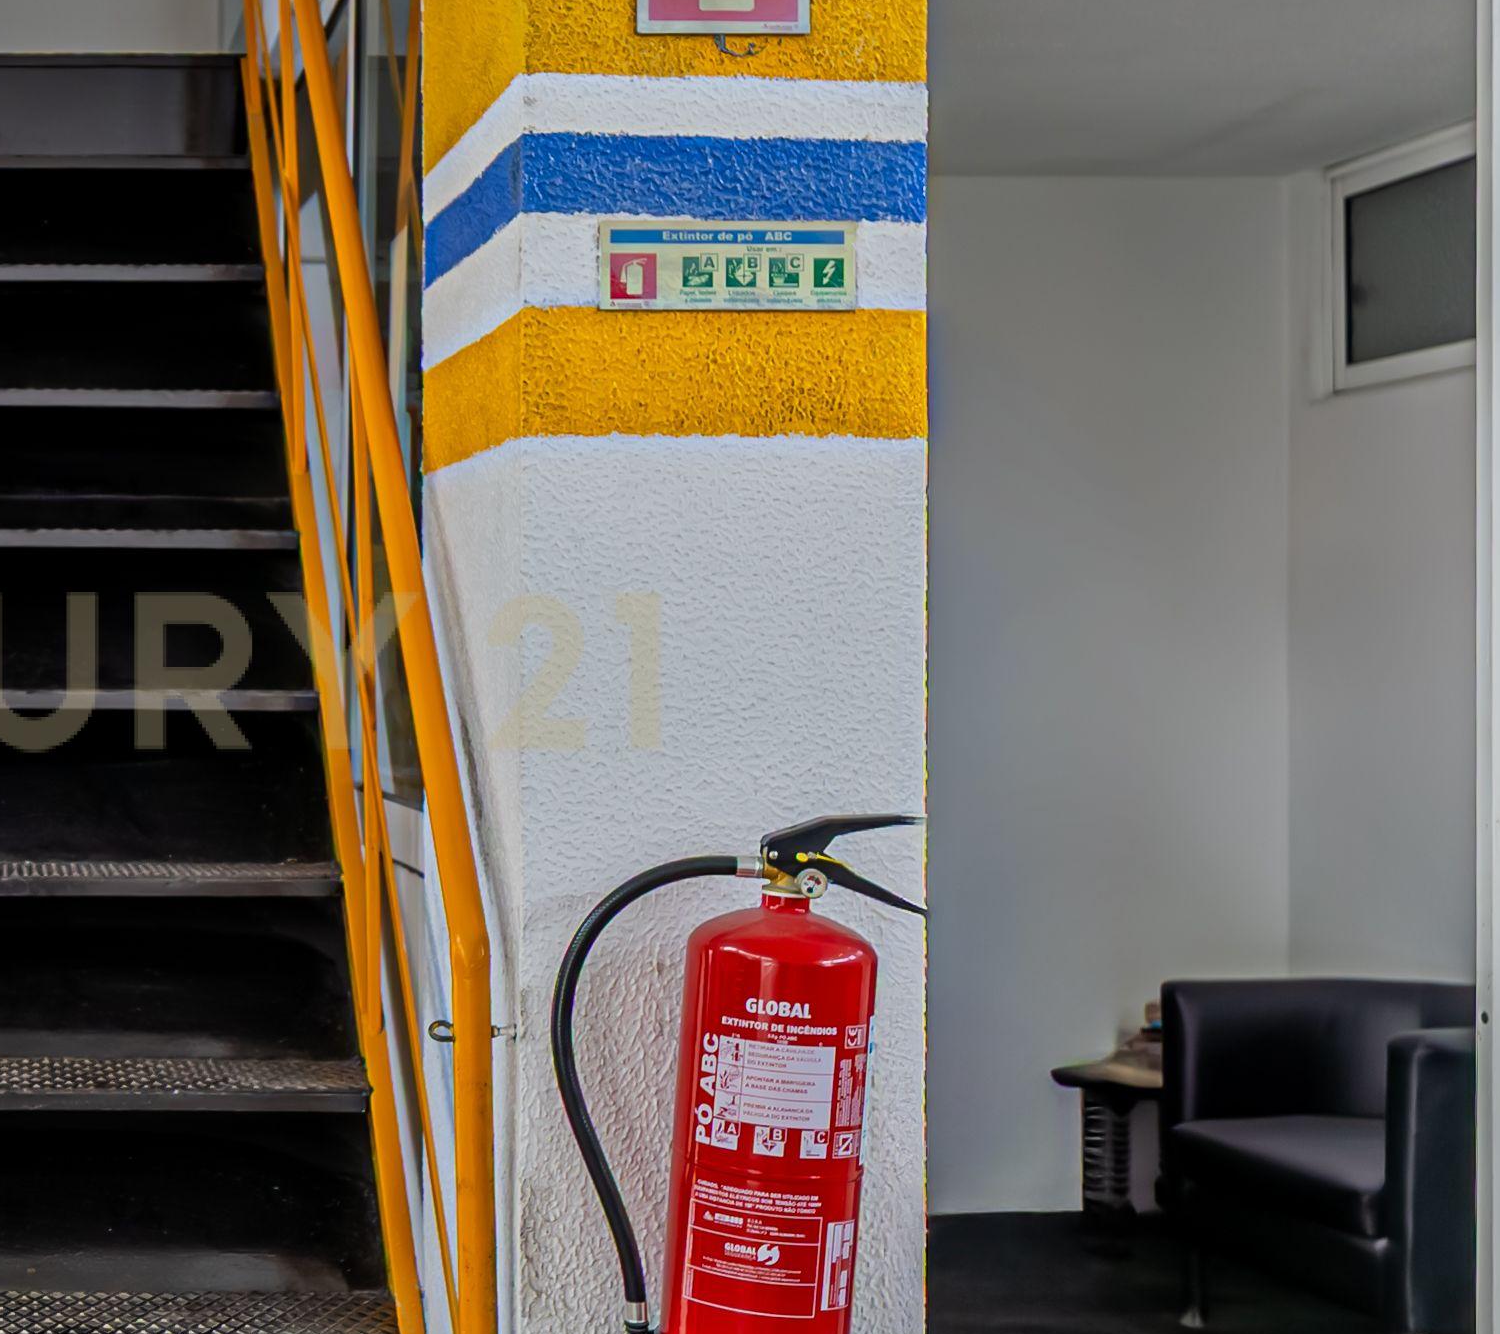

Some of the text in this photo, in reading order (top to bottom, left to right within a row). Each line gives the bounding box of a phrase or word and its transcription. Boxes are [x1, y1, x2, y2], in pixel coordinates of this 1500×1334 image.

[662, 231, 793, 244] Extintor de pó ABC
[703, 257, 715, 269] A
[747, 257, 758, 269] B
[790, 257, 801, 269] C
[745, 998, 812, 1019] GLOBAL
[721, 1016, 837, 1036] EXTINTOR DE INCÊNDIOS
[695, 1032, 719, 1145] PÓ ABC
[727, 1126, 737, 1134] A
[773, 1130, 783, 1140] B
[817, 1132, 826, 1143] C
[724, 1242, 757, 1255] GLOBAL
